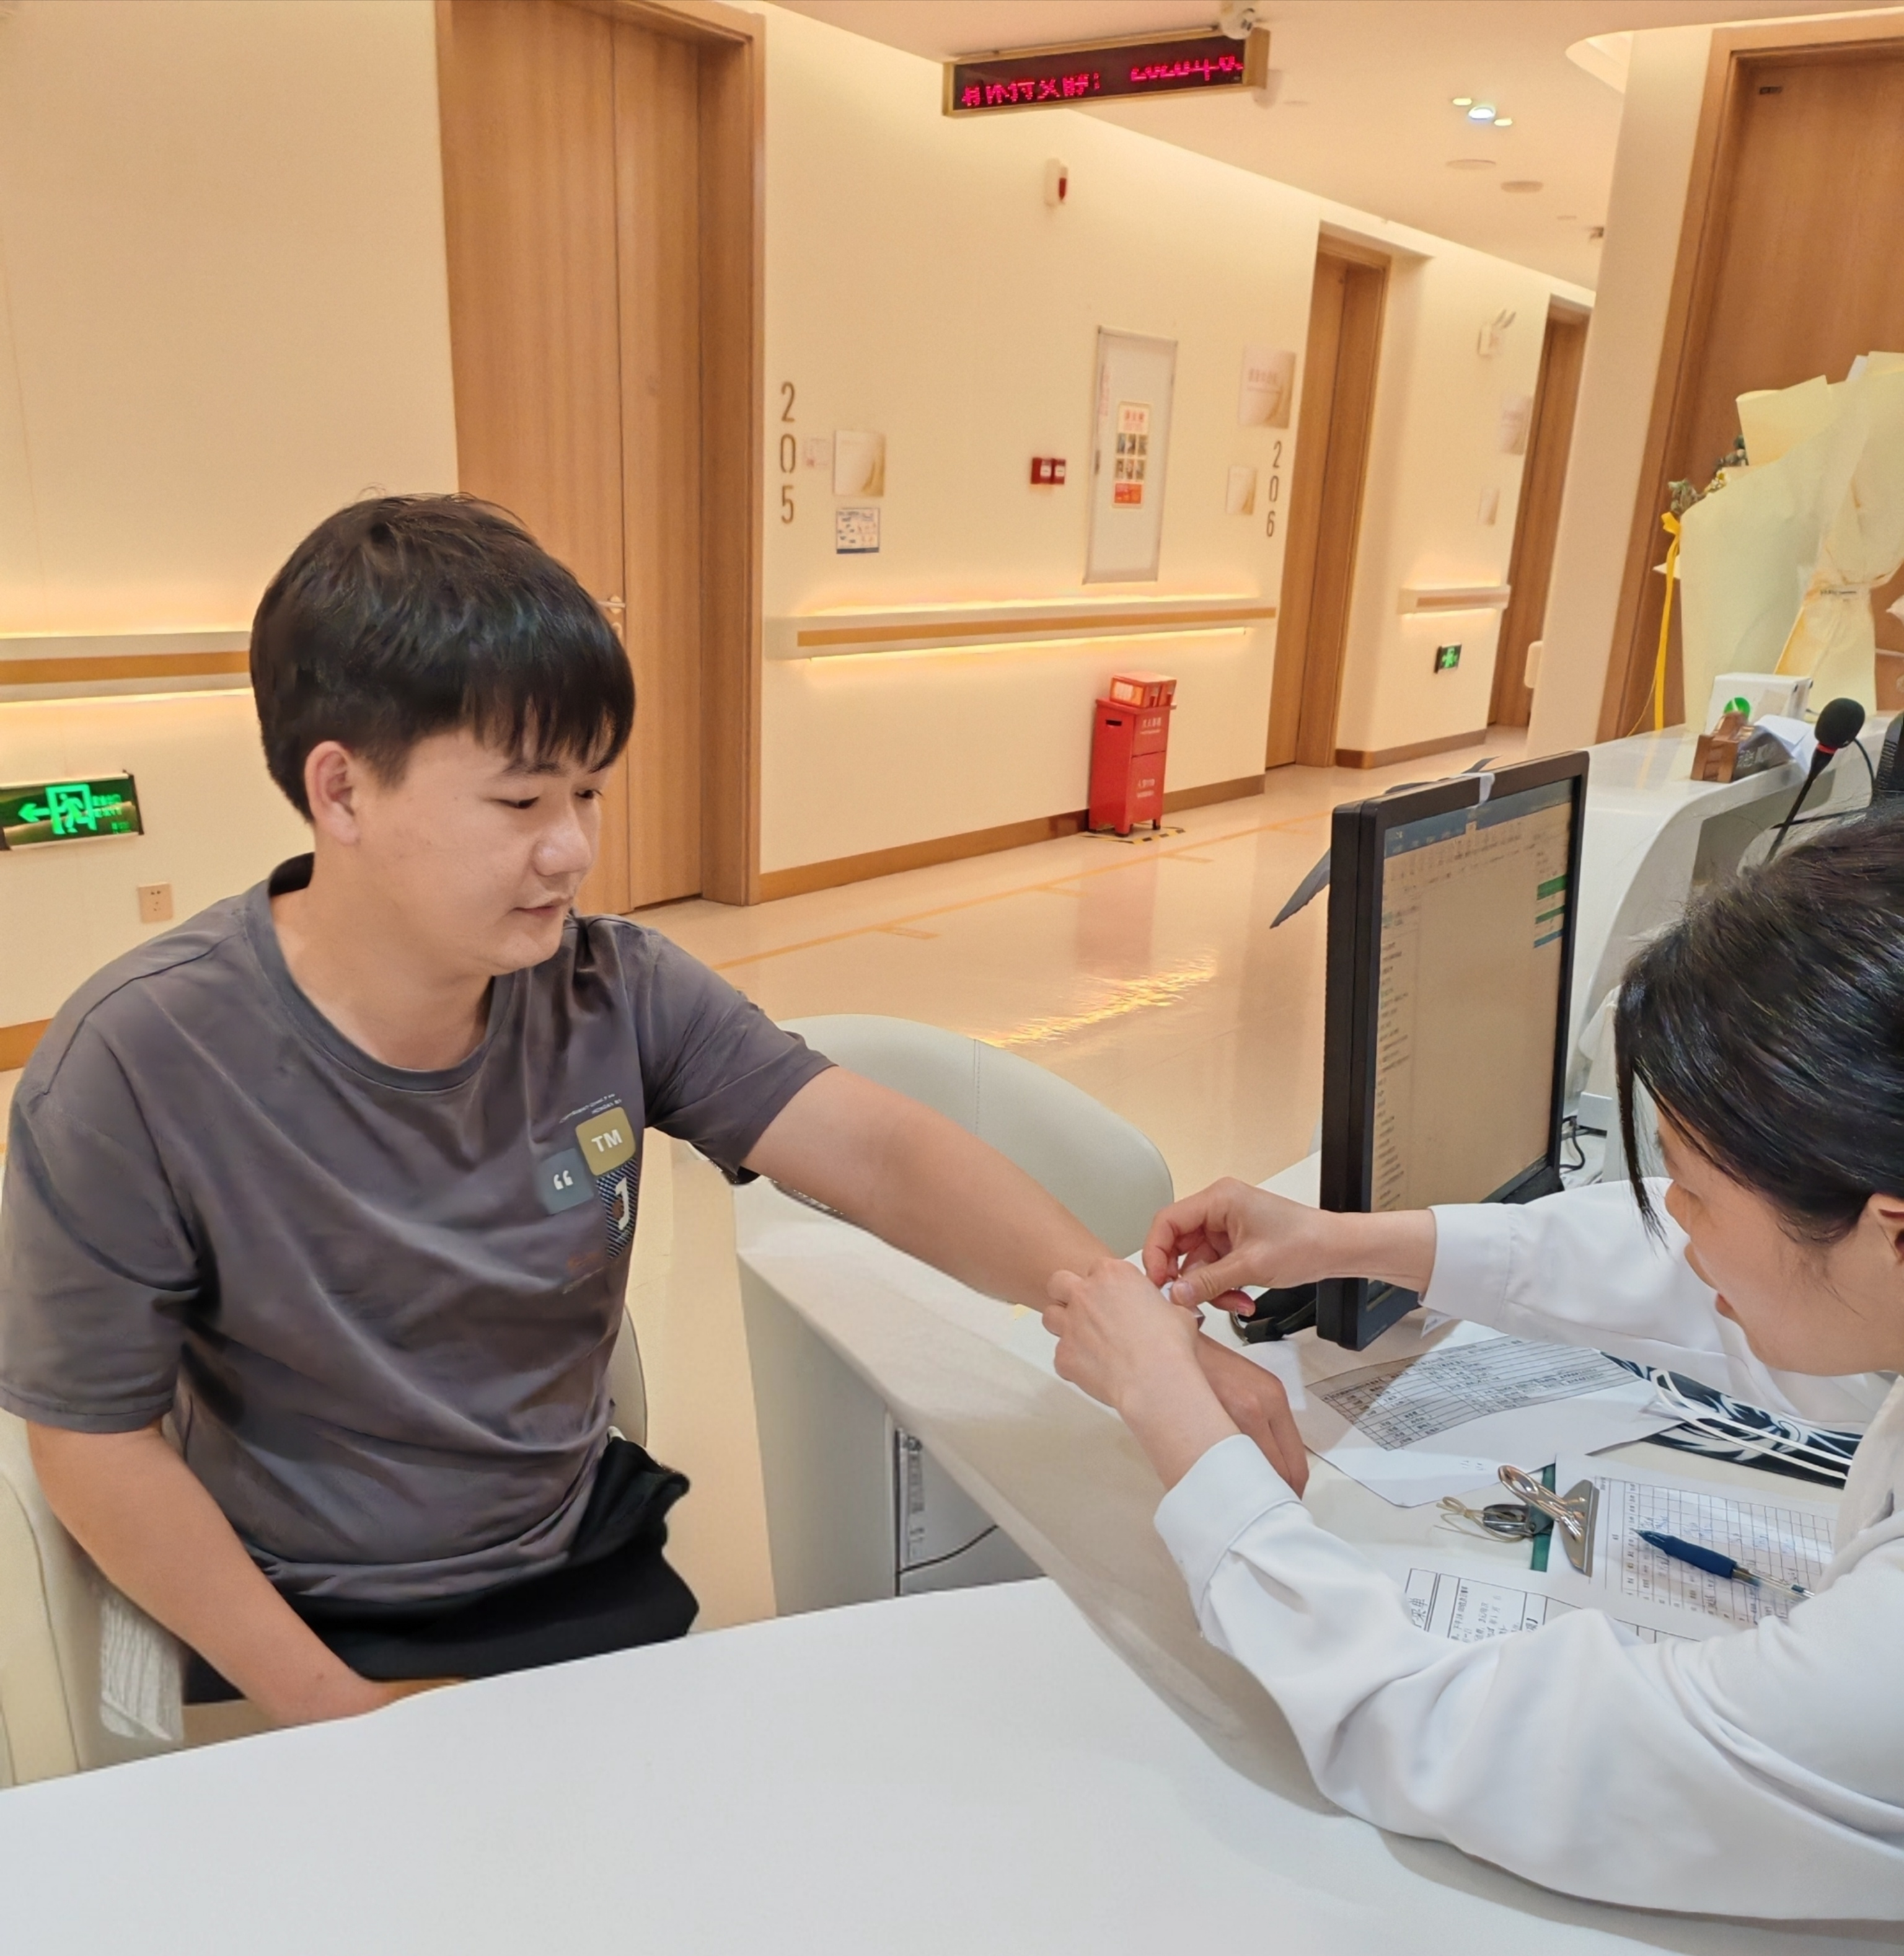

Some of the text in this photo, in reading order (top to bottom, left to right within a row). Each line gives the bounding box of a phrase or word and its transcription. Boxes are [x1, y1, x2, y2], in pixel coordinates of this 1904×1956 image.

[780, 381, 796, 524] 205
[1266, 440, 1282, 537] 206
[591, 1129, 623, 1153] TM
